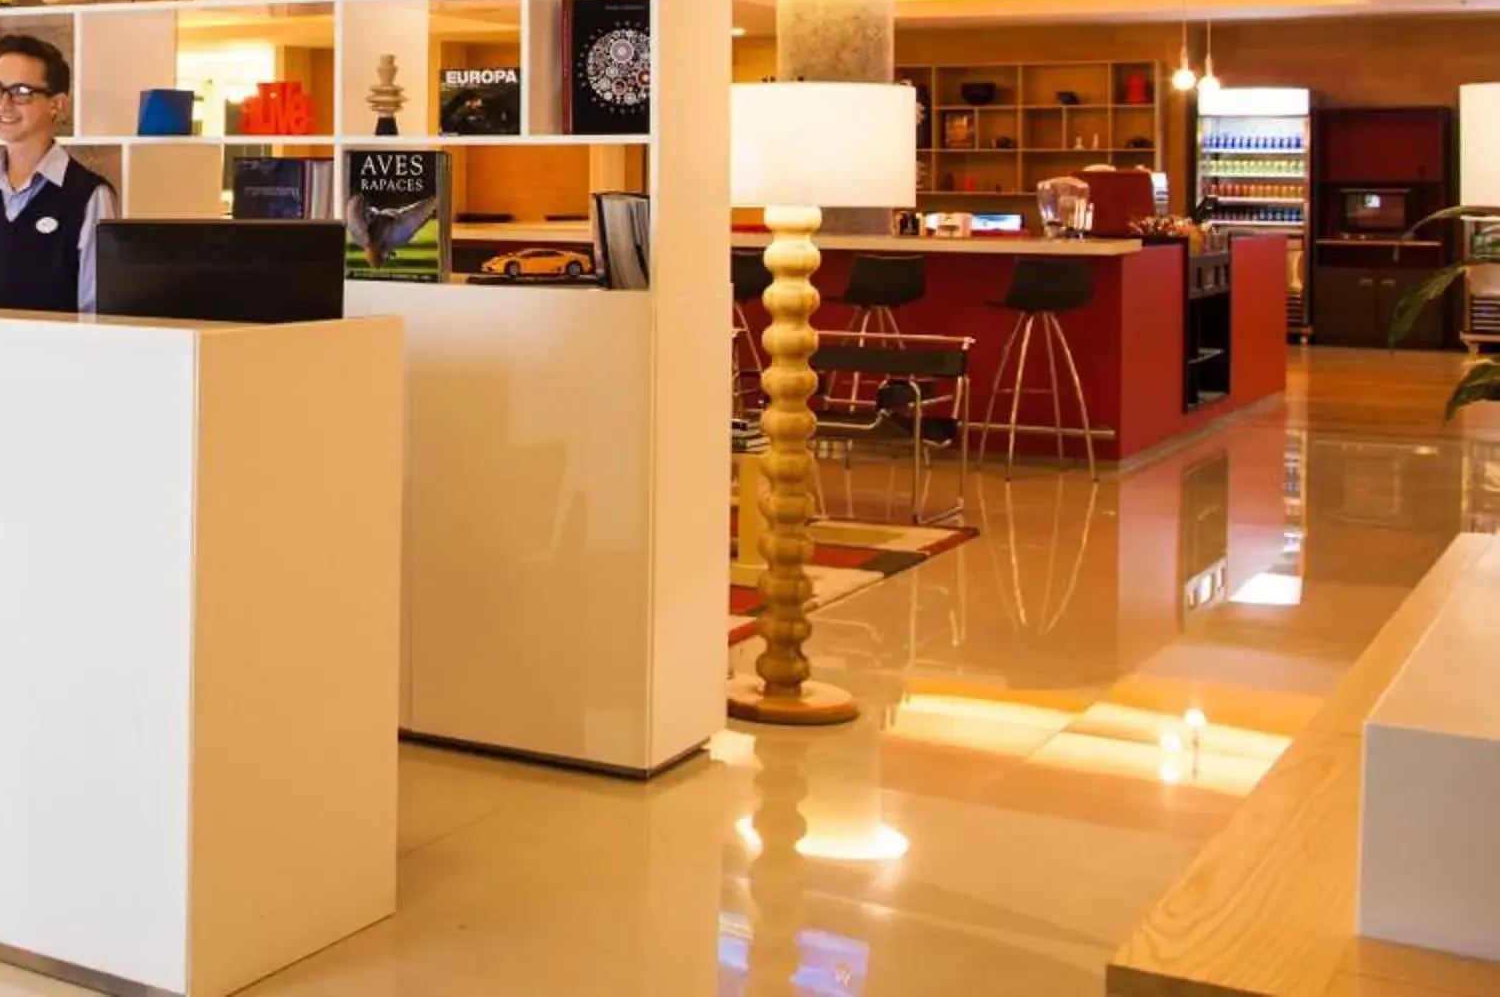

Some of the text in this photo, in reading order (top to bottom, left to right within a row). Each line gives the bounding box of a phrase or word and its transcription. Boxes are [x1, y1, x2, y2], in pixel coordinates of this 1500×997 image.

[446, 69, 517, 84] EUROPA
[361, 154, 423, 176] AVES
[361, 178, 424, 191] RAPACES
